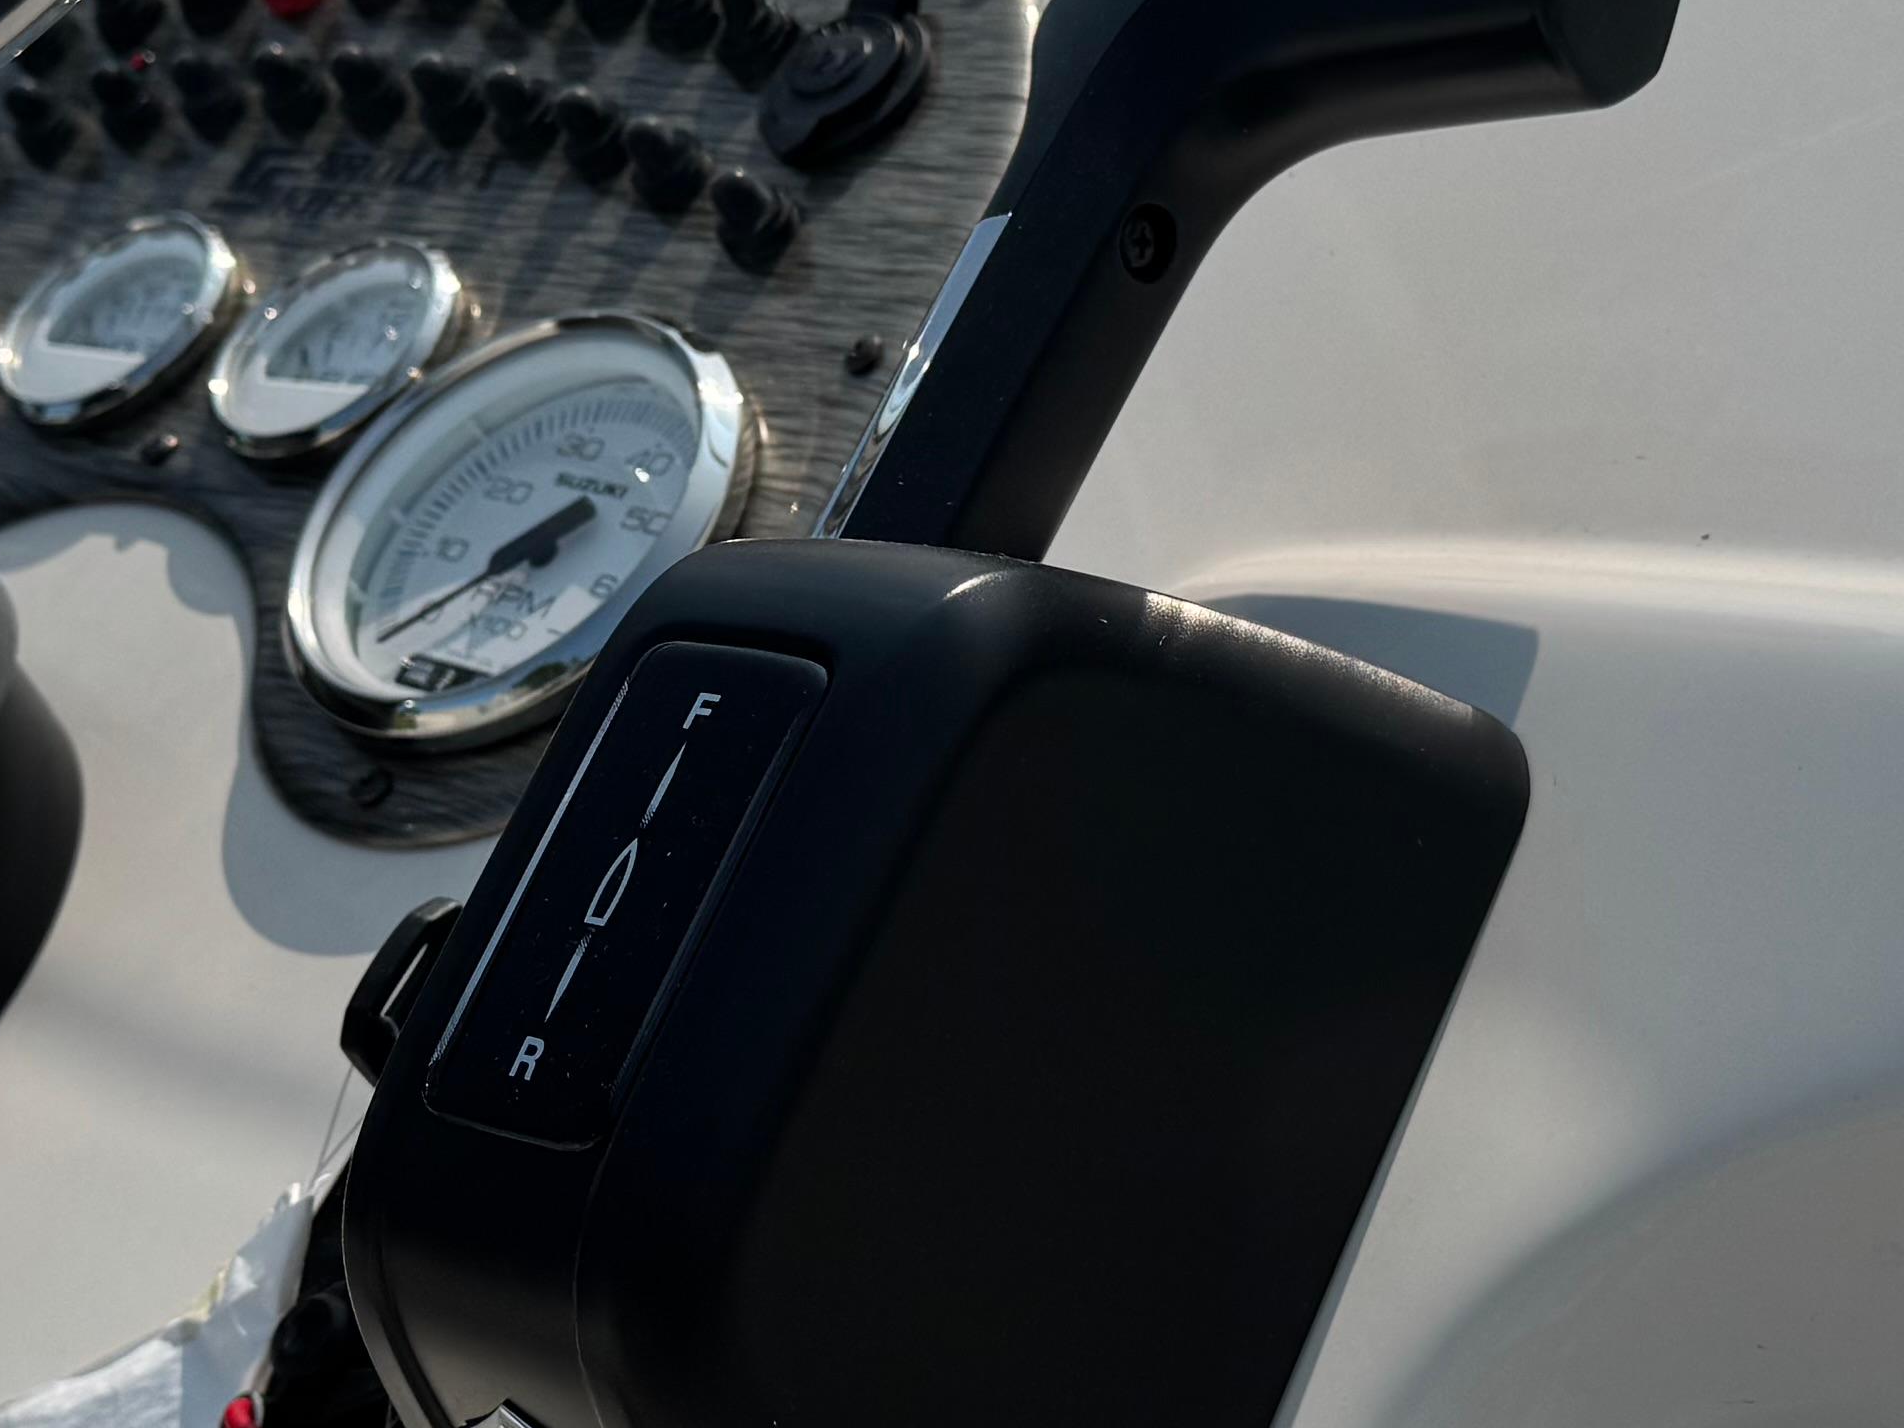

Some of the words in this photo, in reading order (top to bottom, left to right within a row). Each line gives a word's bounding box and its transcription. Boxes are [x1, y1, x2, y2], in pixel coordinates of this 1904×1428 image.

[554, 472, 629, 500] SUZUKI
[682, 692, 722, 730] F
[508, 1035, 545, 1081] R
